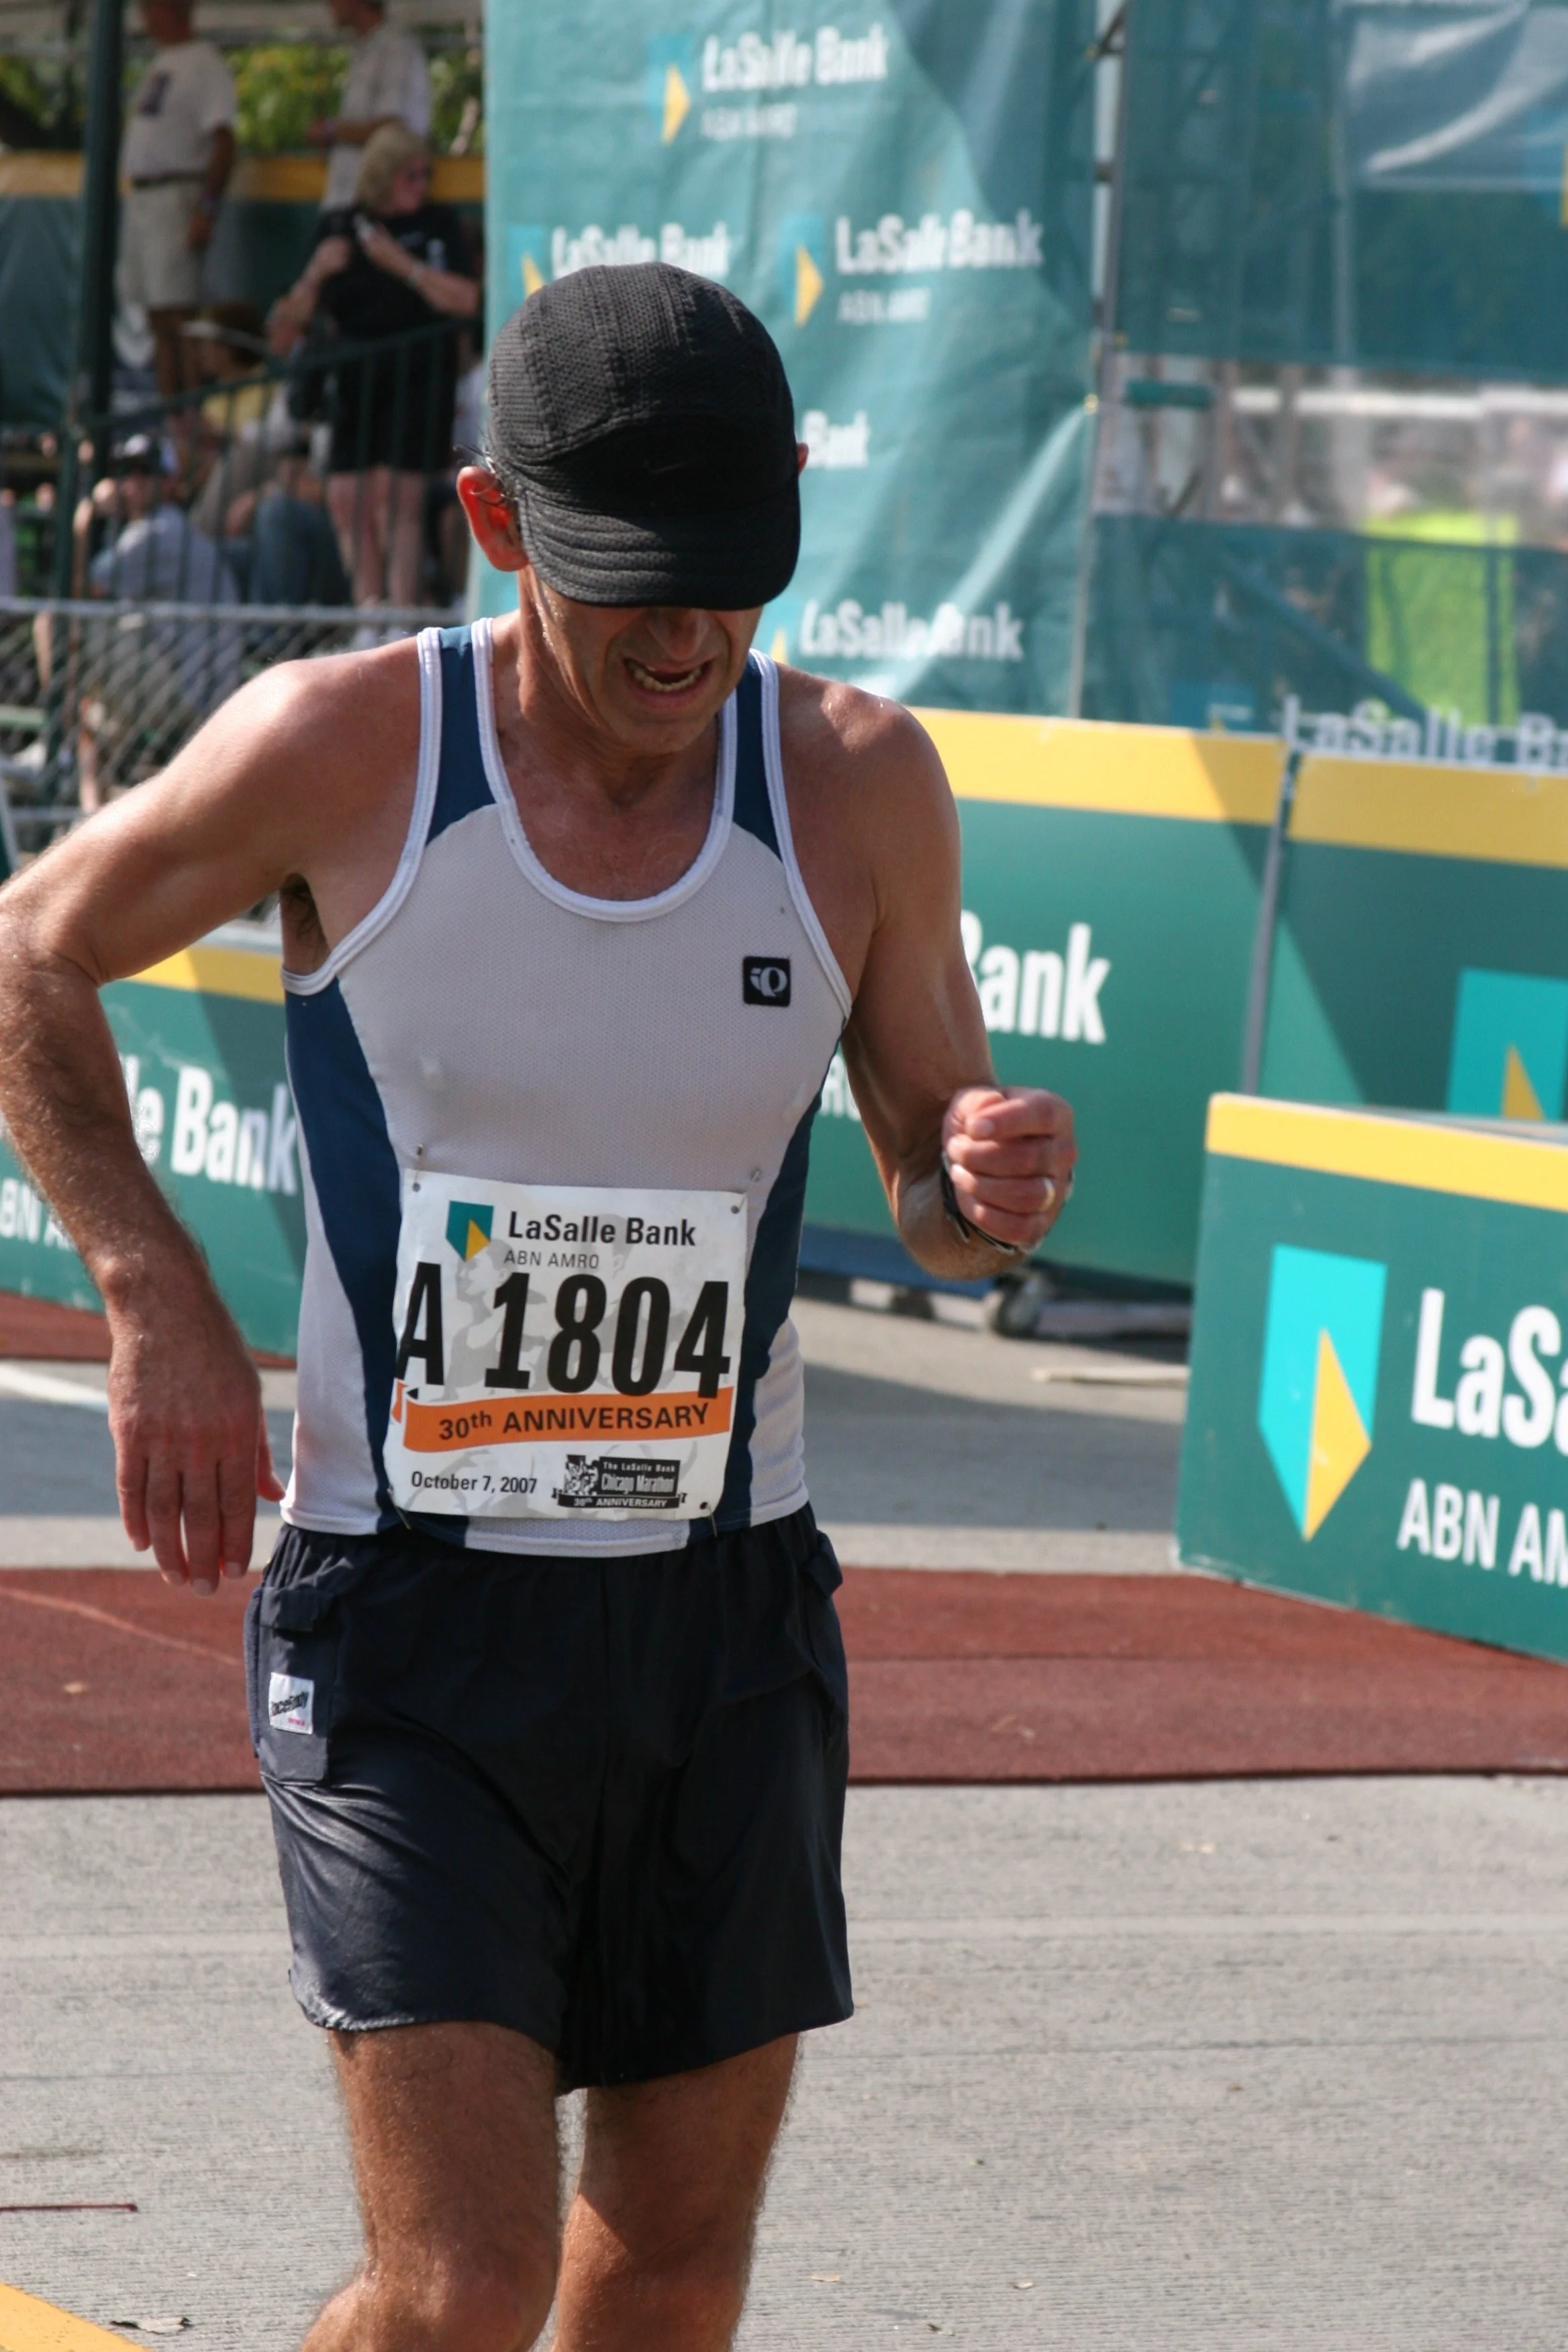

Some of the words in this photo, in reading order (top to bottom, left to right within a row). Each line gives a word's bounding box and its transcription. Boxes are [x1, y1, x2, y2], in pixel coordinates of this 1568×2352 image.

[170, 1066, 299, 1197] Bank
[508, 1210, 616, 1243] LaSalle
[625, 1216, 696, 1246] Bank
[503, 1248, 542, 1267] ABN
[547, 1251, 599, 1269] AMRO
[395, 1261, 444, 1386] A
[484, 1272, 731, 1400] 1804
[438, 1411, 492, 1441] 30th
[503, 1402, 709, 1434] ANNIVERSARY
[411, 1471, 477, 1492] October
[483, 1475, 497, 1494] 7,
[501, 1476, 538, 1494] 2007
[596, 1498, 668, 1508] ANNIVERSARY
[1396, 1477, 1500, 1571] ABN
